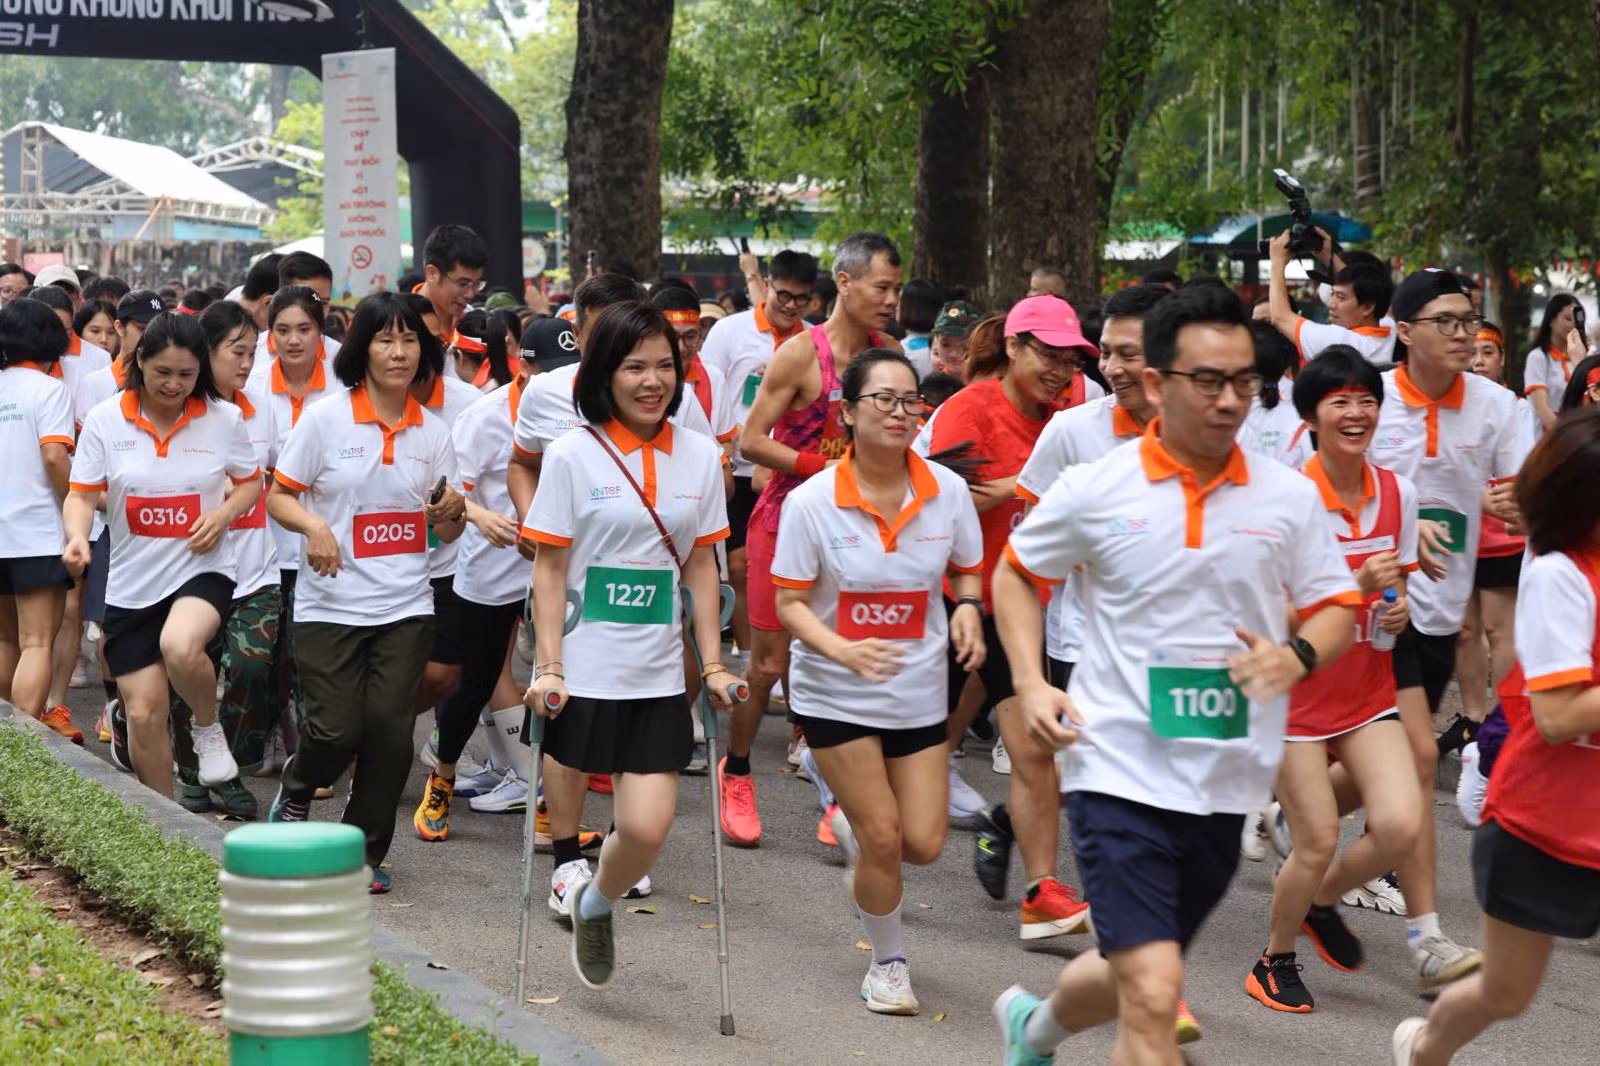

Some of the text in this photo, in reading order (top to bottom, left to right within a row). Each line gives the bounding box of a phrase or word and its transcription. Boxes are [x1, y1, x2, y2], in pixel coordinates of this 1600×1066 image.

[139, 507, 188, 526] 0316
[363, 523, 416, 544] 0205
[605, 583, 657, 607] 1227
[851, 603, 914, 625] 0367
[1168, 687, 1237, 717] 1100
